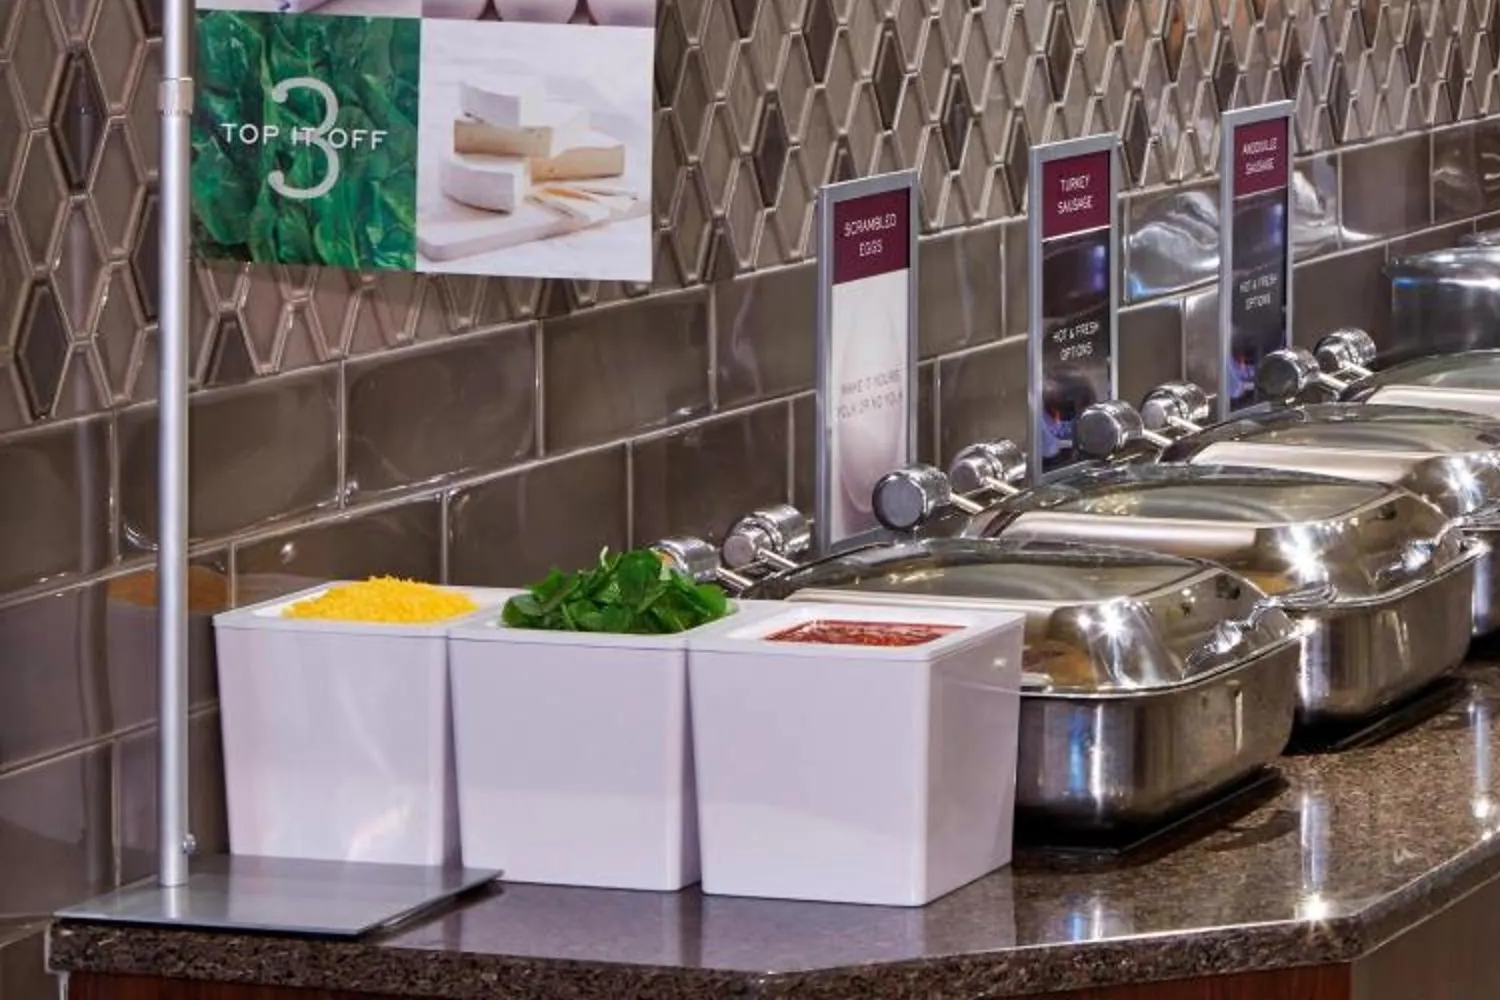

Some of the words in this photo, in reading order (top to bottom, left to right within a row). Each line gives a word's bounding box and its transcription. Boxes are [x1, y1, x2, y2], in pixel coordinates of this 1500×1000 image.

[220, 123, 279, 145] TOP
[291, 126, 318, 147] IT
[328, 128, 388, 150] OFF
[268, 76, 340, 198] 3
[1060, 174, 1090, 192] TURKEY
[1057, 195, 1093, 215] SAUSAGE
[844, 213, 897, 237] SCRAMBLED
[859, 239, 883, 256] EGGS
